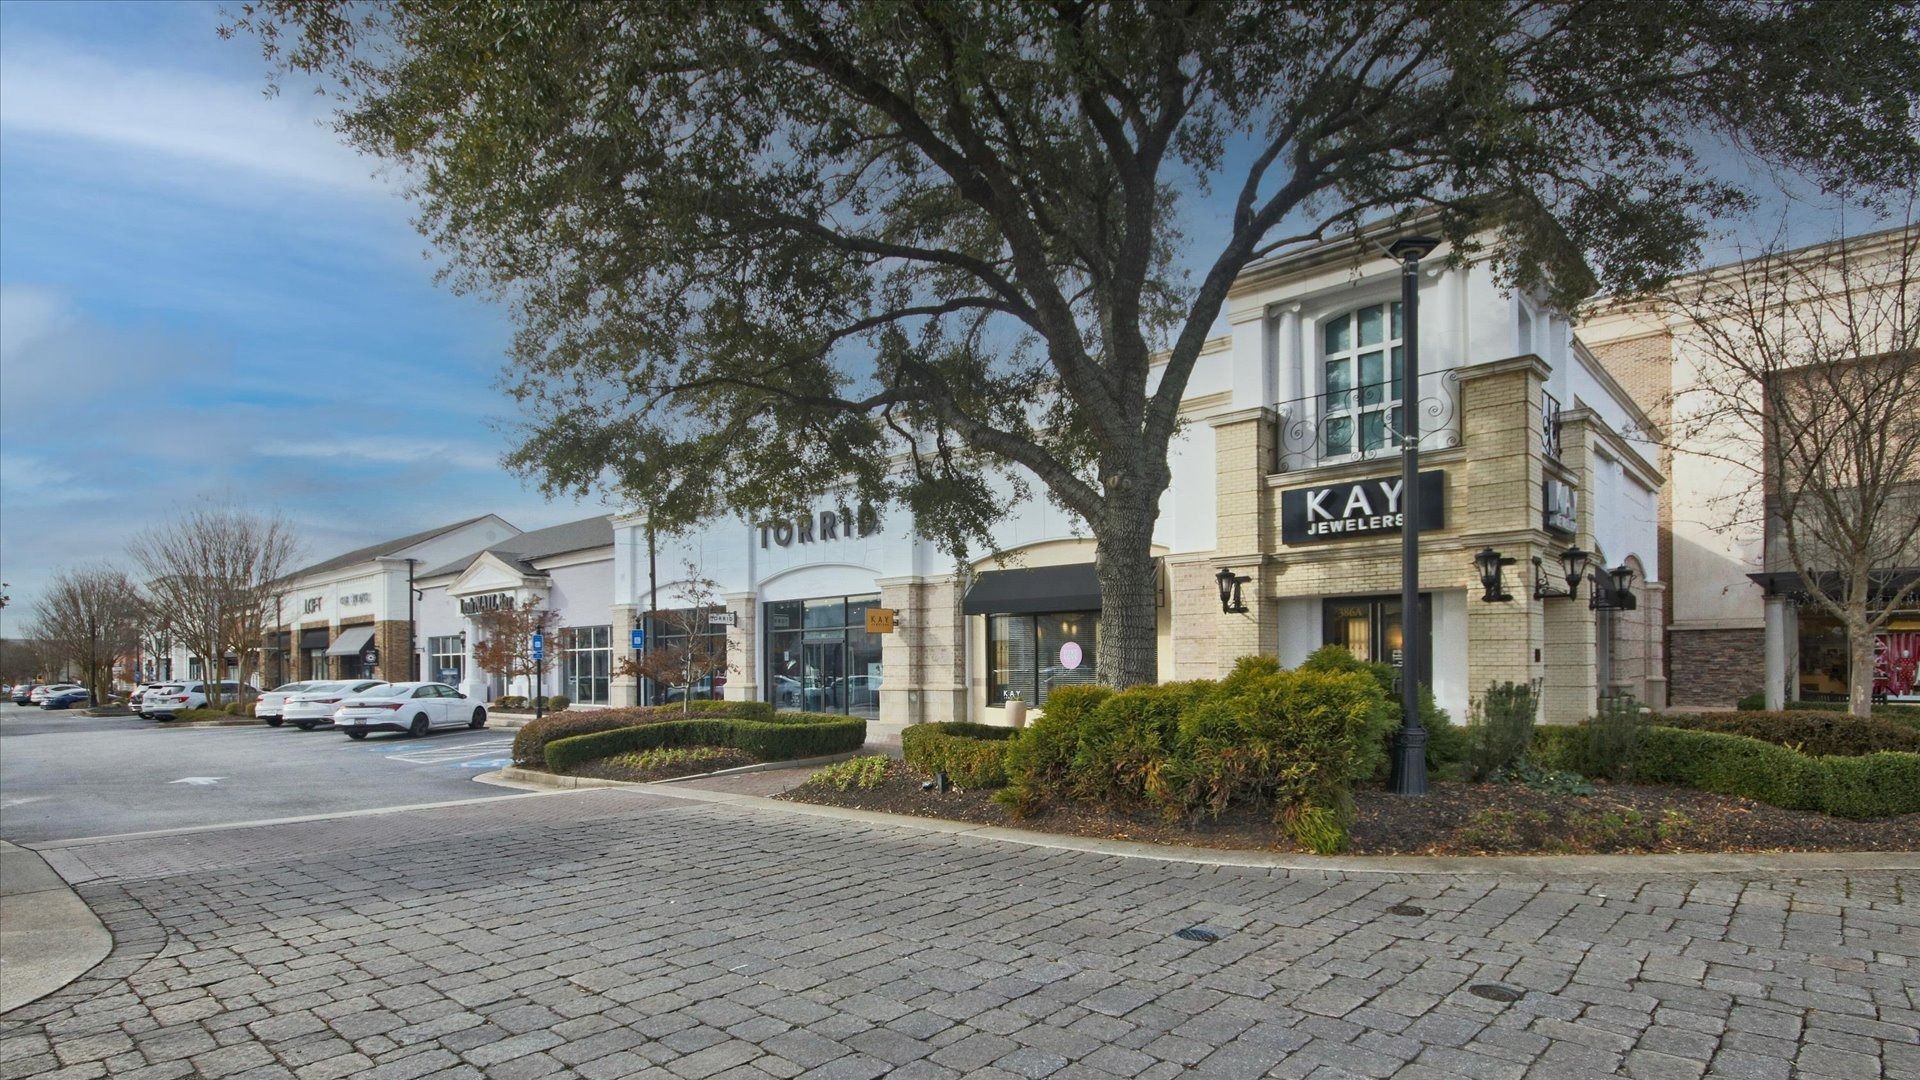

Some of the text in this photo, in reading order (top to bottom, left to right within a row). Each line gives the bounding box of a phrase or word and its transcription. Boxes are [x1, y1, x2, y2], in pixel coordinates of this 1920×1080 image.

[1307, 479, 1403, 522] KAY
[757, 503, 878, 549] TORRID
[1307, 513, 1403, 535] JEWELERS
[303, 596, 323, 615] LOFT
[870, 615, 889, 624] KAY
[1003, 690, 1021, 698] KAY
